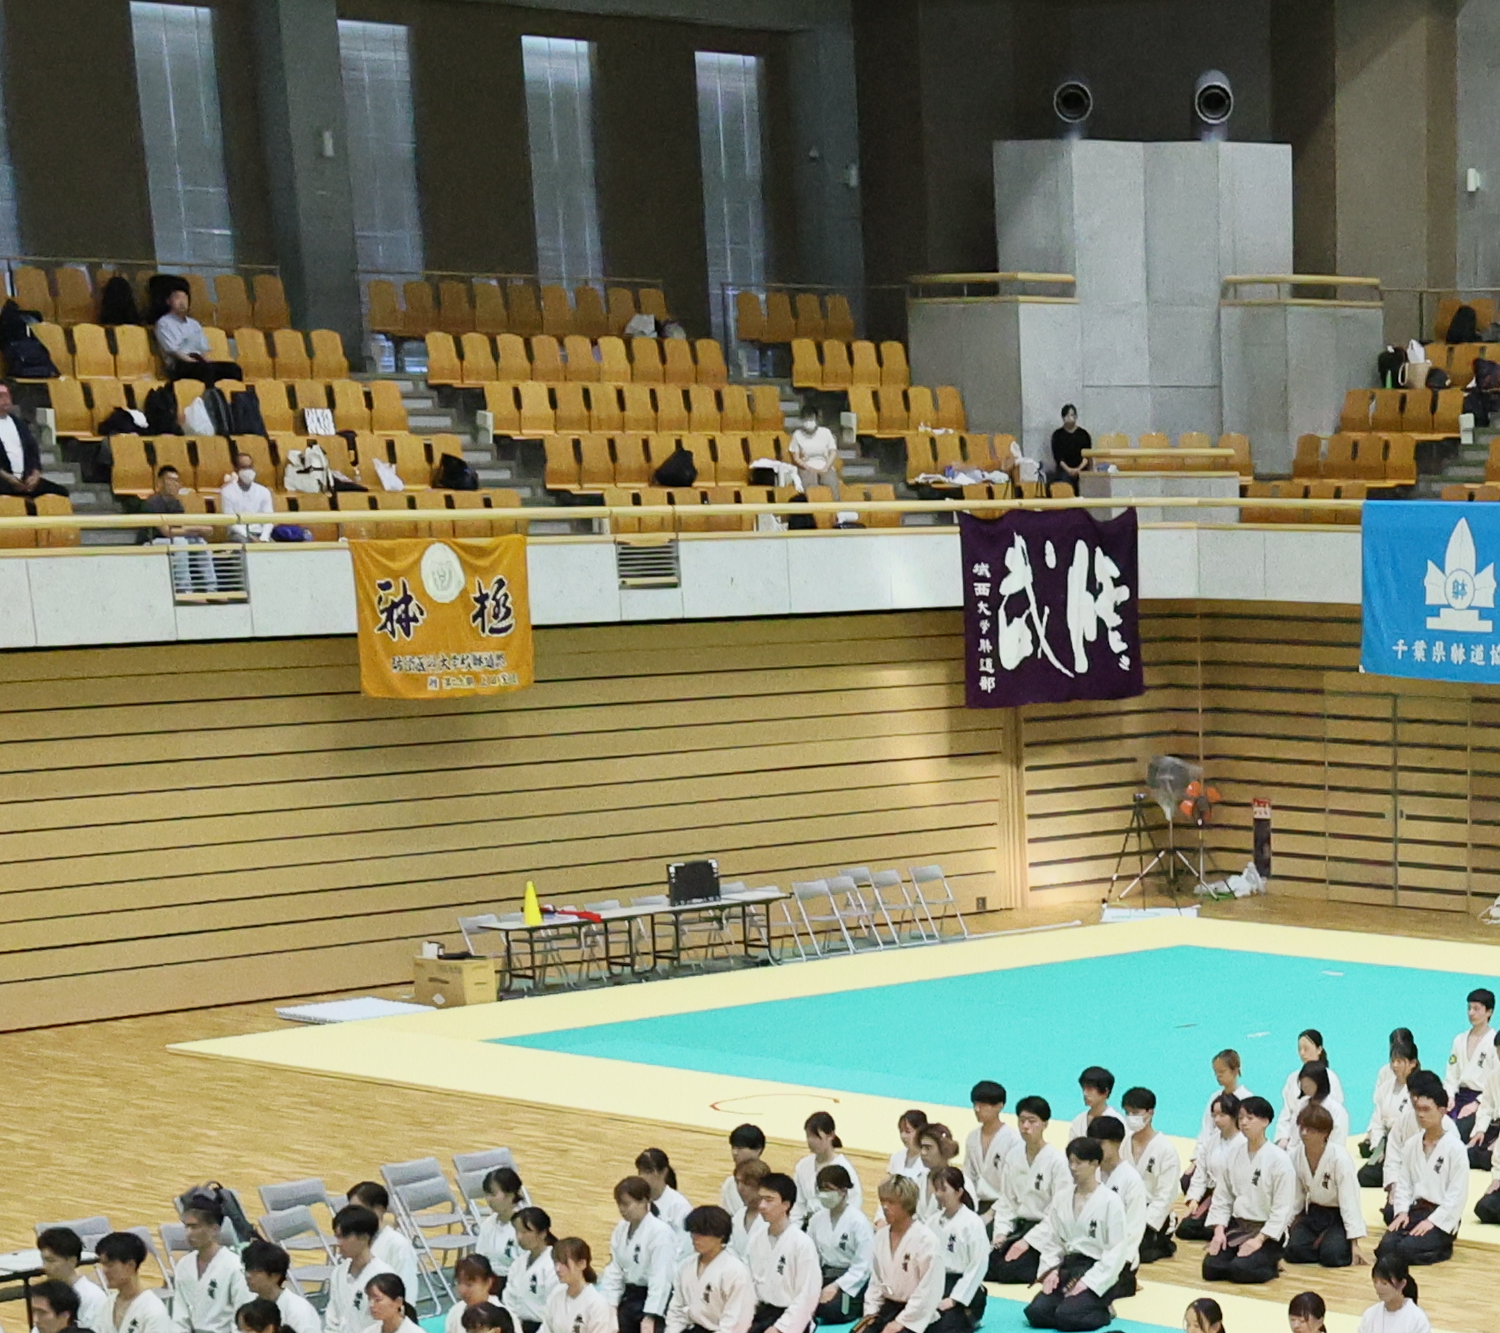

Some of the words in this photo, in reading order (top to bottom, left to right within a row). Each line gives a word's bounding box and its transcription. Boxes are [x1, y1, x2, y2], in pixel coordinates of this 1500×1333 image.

[972, 561, 996, 694] 城西大学躰道部
